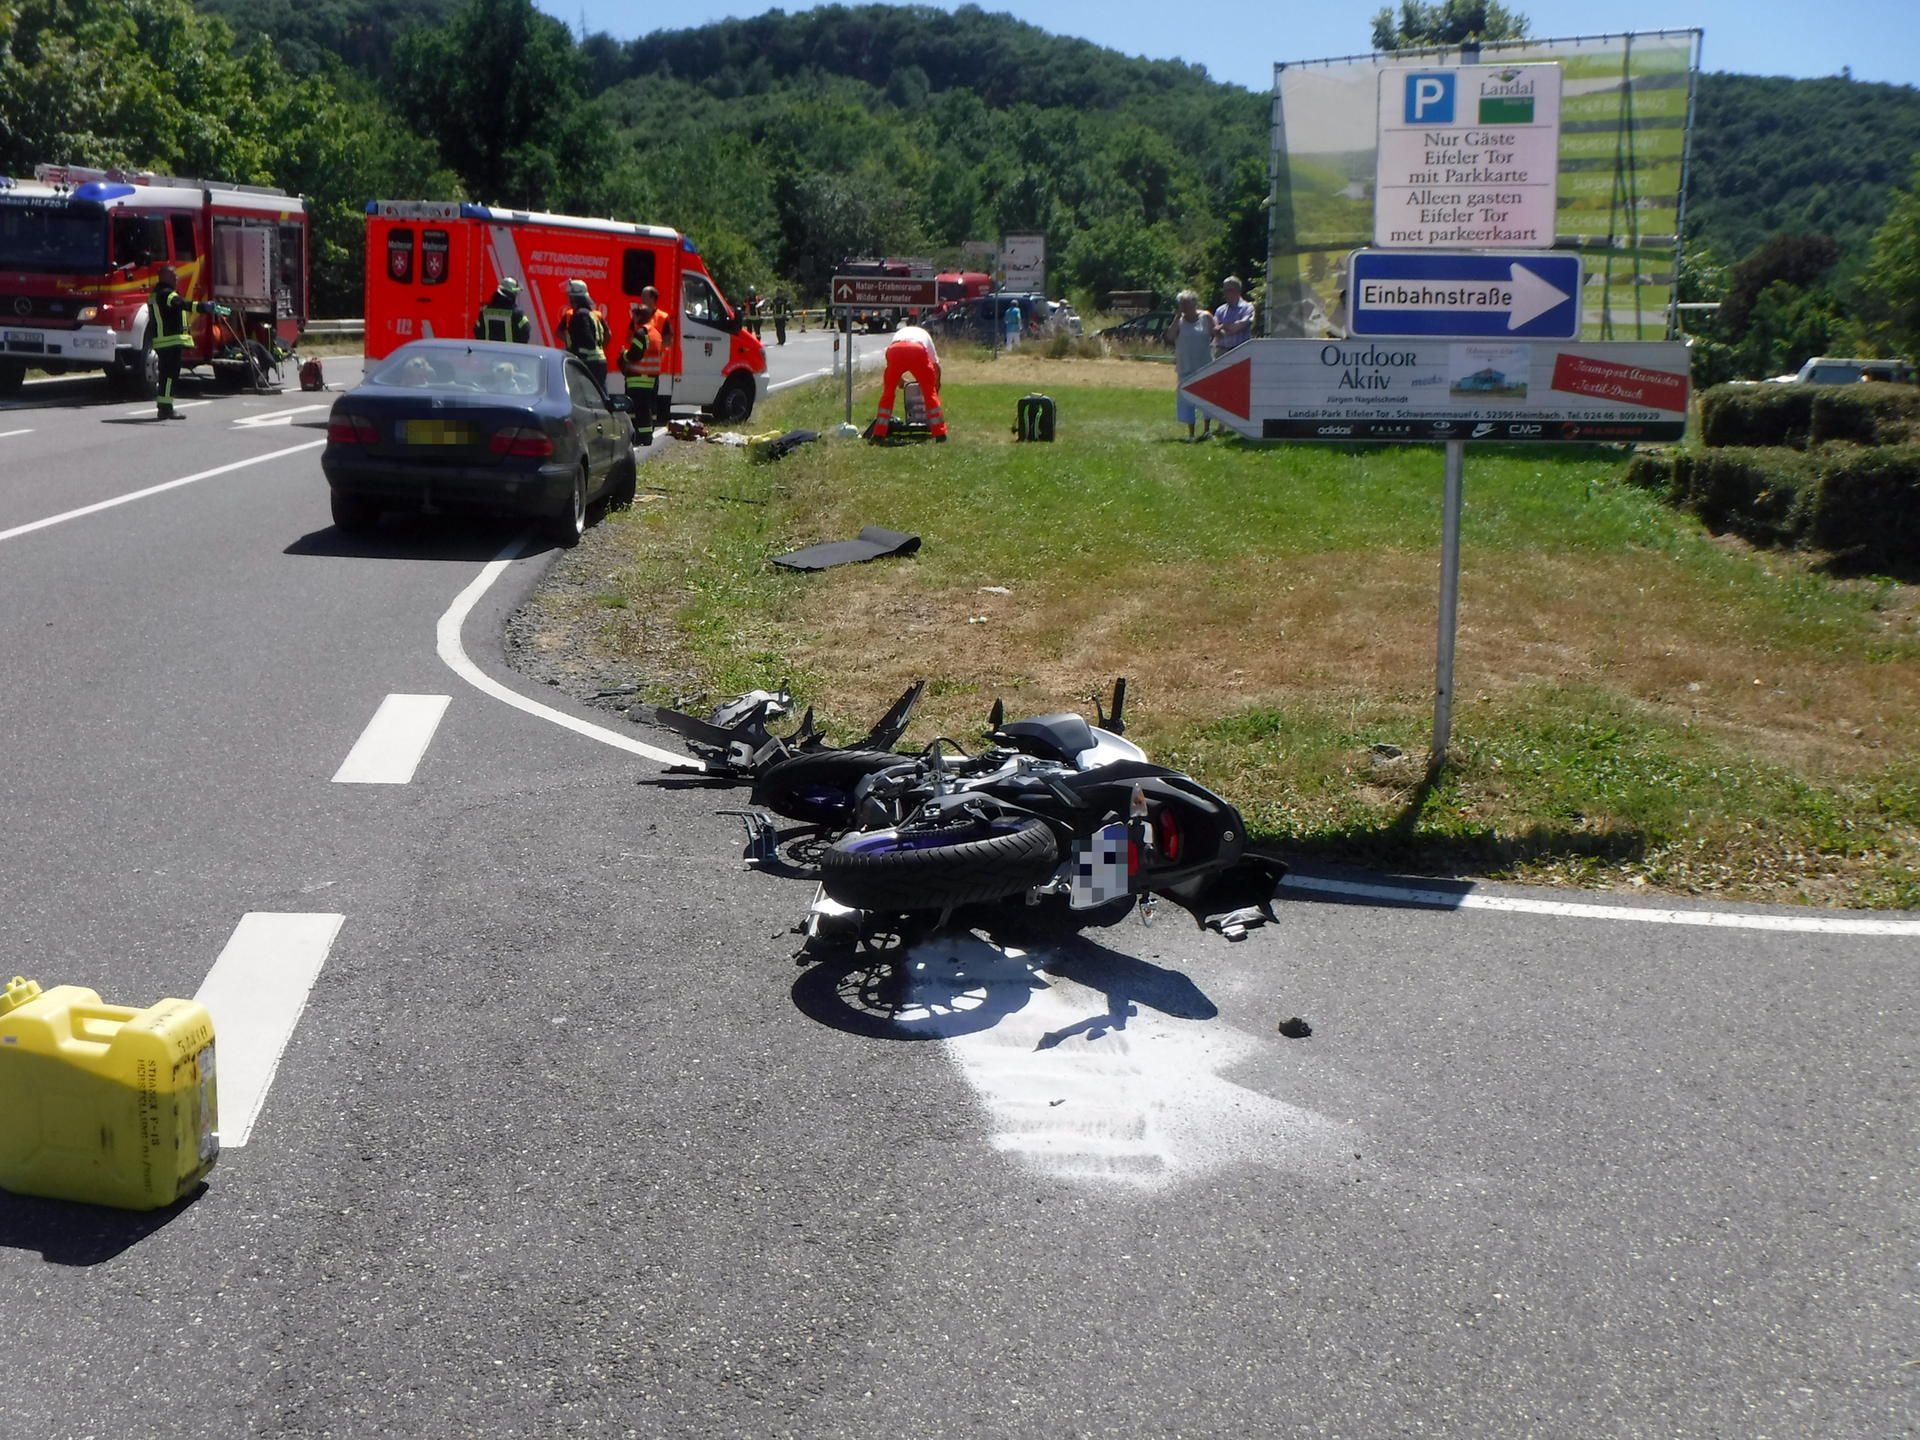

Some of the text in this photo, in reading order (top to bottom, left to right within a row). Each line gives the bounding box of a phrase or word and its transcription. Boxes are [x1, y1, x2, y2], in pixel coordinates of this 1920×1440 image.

[1480, 80, 1534, 96] Landal
[1415, 78, 1444, 119] P
[1424, 132, 1516, 147] Nur Gäste
[1424, 150, 1514, 165] Eifeler Tor
[1409, 168, 1528, 183] mit Parkkarte
[1406, 190, 1522, 207] Alleen gasten
[1420, 208, 1509, 223] Eifeler Tor
[1391, 226, 1537, 244] met parkeerkaart
[531, 250, 609, 267] RETTUNGSDIENST
[1365, 285, 1512, 305] Einbahnstraße
[1320, 344, 1417, 367] Outdoor
[1337, 367, 1391, 390] Aktiv
[1326, 396, 1353, 405] Jürgen
[1288, 409, 1341, 417] Landal-Park
[1345, 409, 1374, 417] Eifeler
[1318, 424, 1354, 434] adidas
[1509, 424, 1542, 434] CMP
